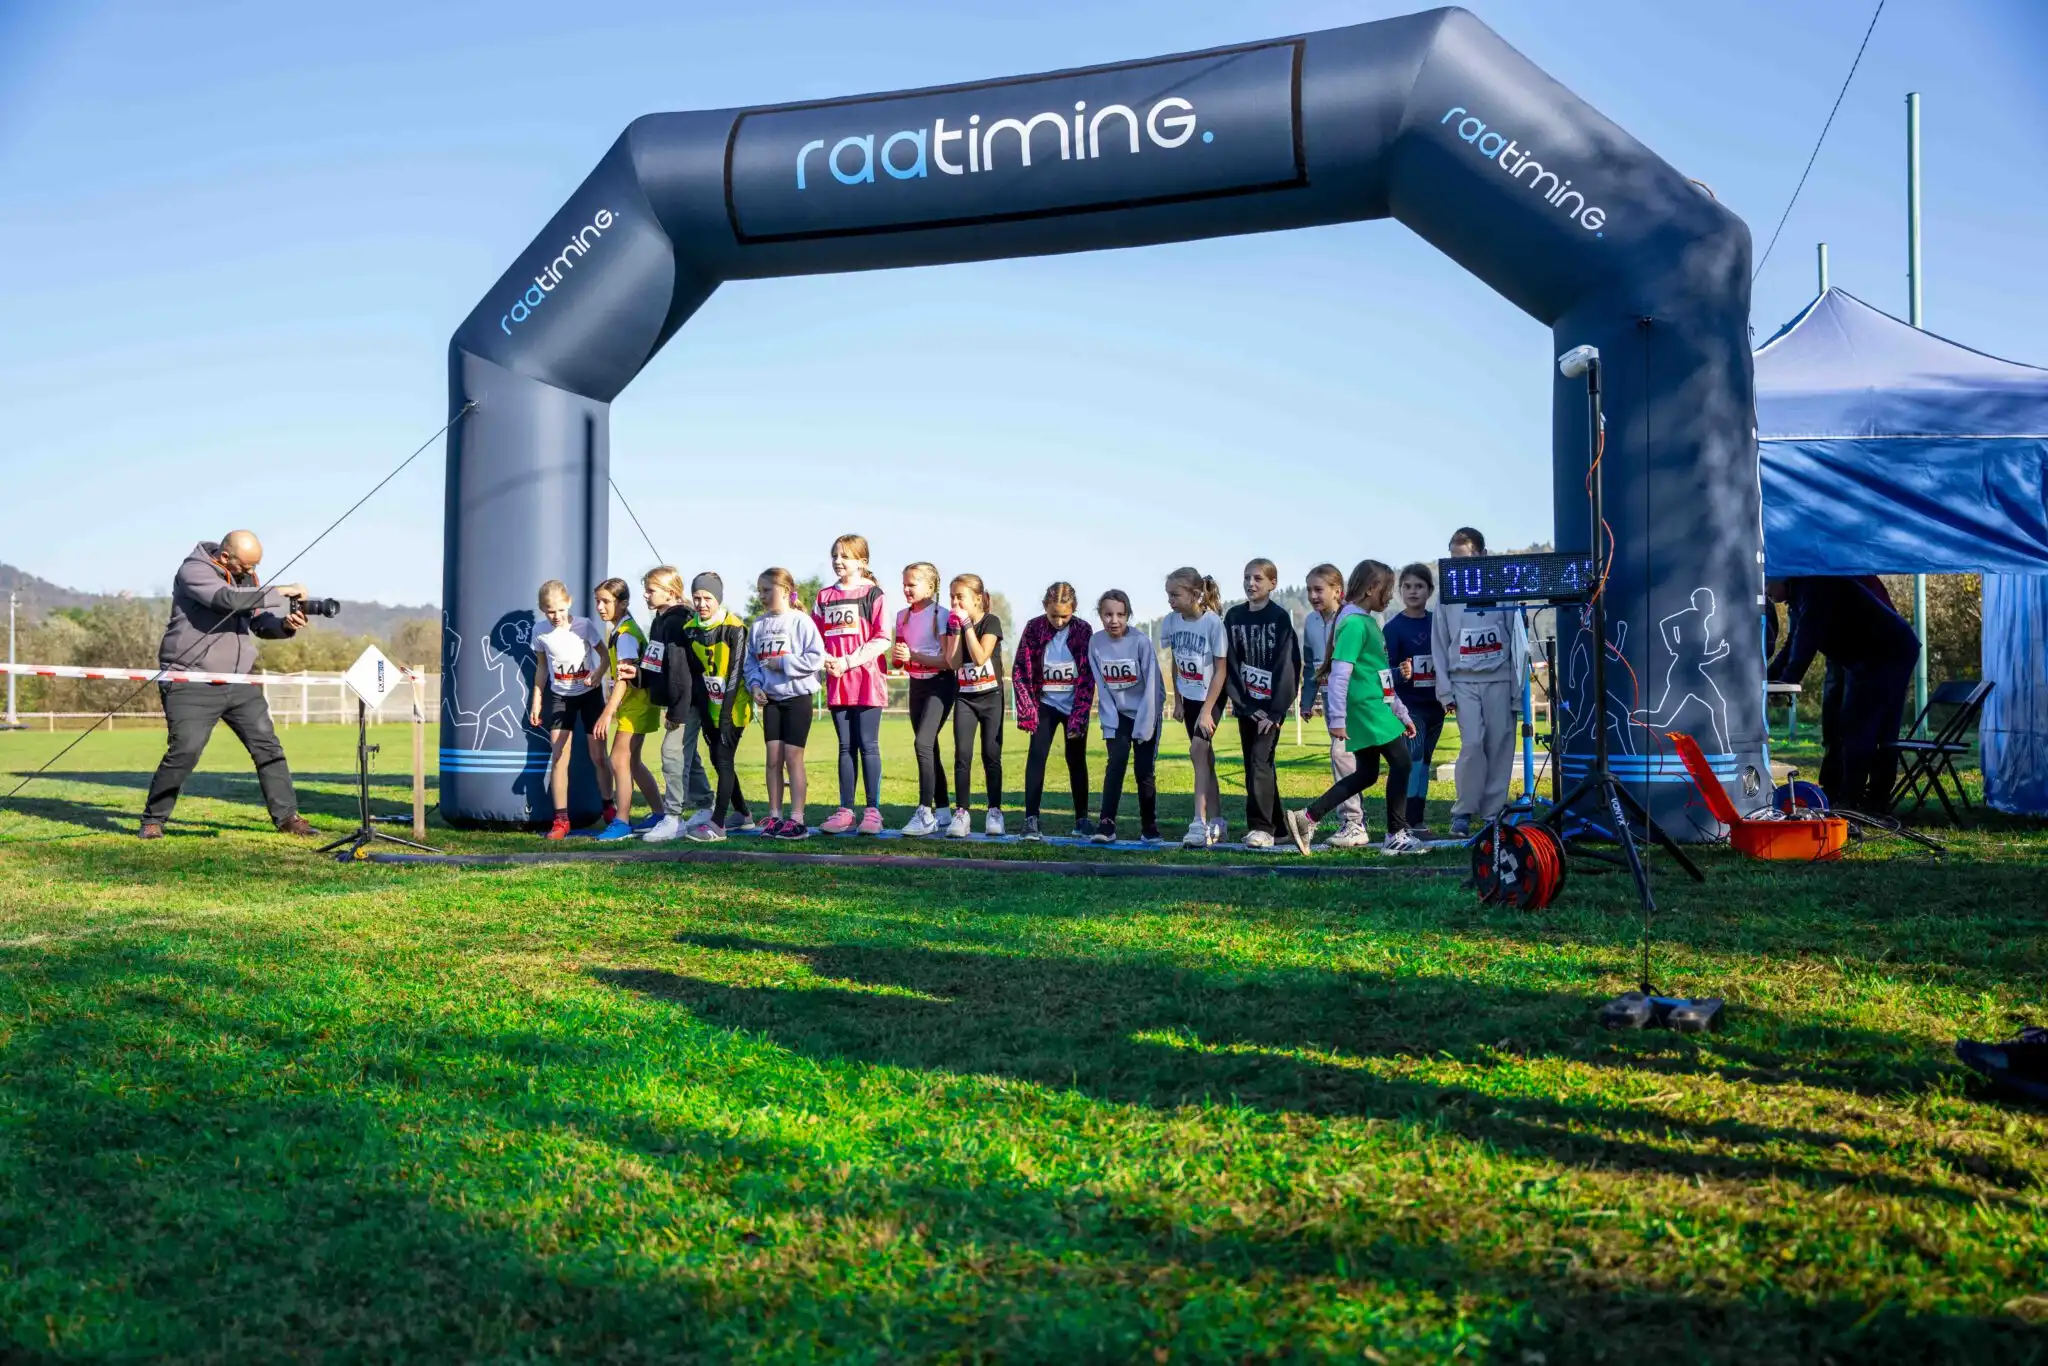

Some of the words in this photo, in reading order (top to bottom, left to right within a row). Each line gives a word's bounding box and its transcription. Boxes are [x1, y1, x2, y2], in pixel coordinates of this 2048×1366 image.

[829, 610, 854, 625] 126
[760, 641, 785, 656] 117
[1231, 623, 1276, 667] PARIS
[1465, 632, 1497, 650] 149
[557, 661, 589, 676] 144
[961, 665, 989, 682] 134
[1044, 668, 1074, 682] 105
[1103, 664, 1131, 680] 106
[1242, 671, 1269, 690] 125
[1611, 797, 1627, 826] VONYX
